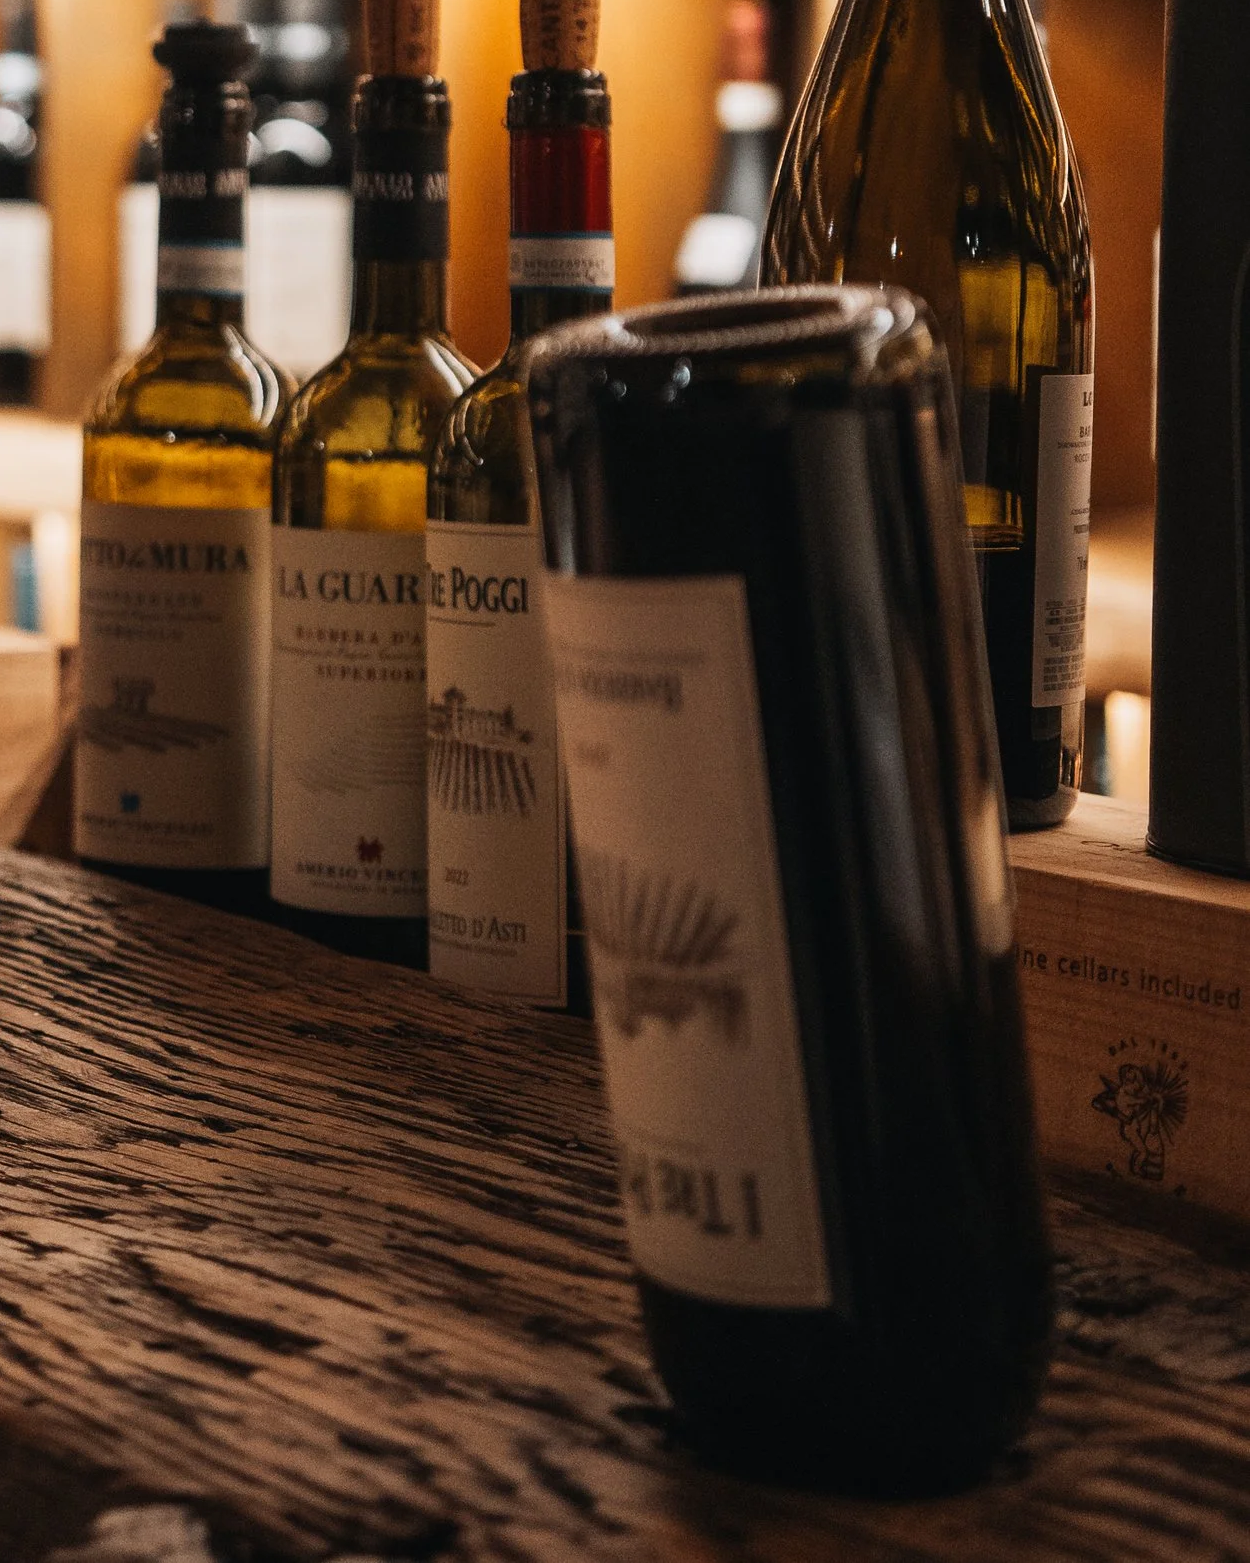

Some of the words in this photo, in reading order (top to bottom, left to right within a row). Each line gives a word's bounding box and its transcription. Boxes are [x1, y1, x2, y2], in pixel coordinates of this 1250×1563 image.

[278, 565, 309, 600] LA
[451, 565, 529, 614] POGGI
[1014, 942, 1048, 970] ine
[1057, 953, 1131, 988] cellars
[1139, 967, 1243, 1010] included
